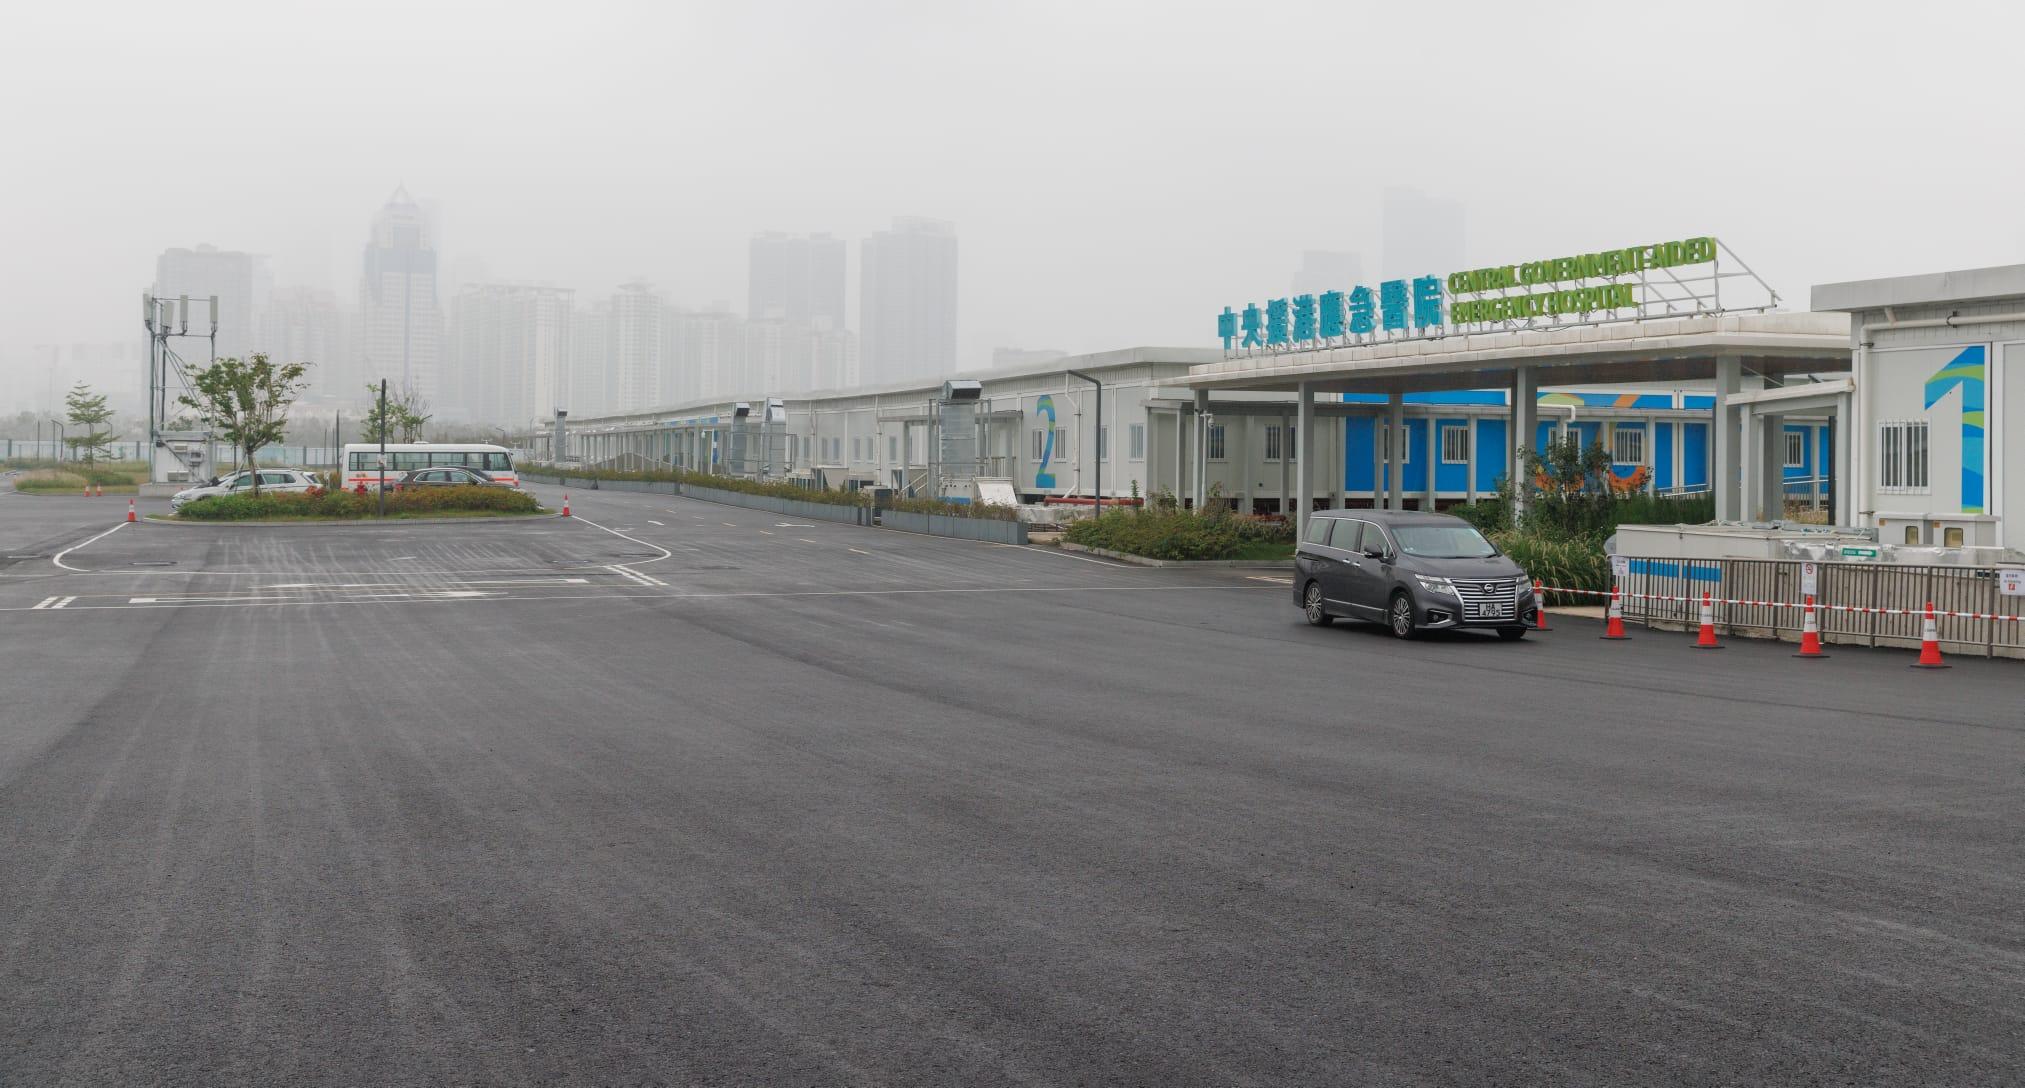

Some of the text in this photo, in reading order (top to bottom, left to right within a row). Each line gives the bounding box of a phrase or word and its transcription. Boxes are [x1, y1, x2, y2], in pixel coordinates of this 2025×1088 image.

[1448, 265, 1520, 294] CENTRAL
[1450, 282, 1639, 325] EMERGENCY HOSPITAL
[1036, 394, 1056, 488] 2
[1924, 345, 1985, 514] 1
